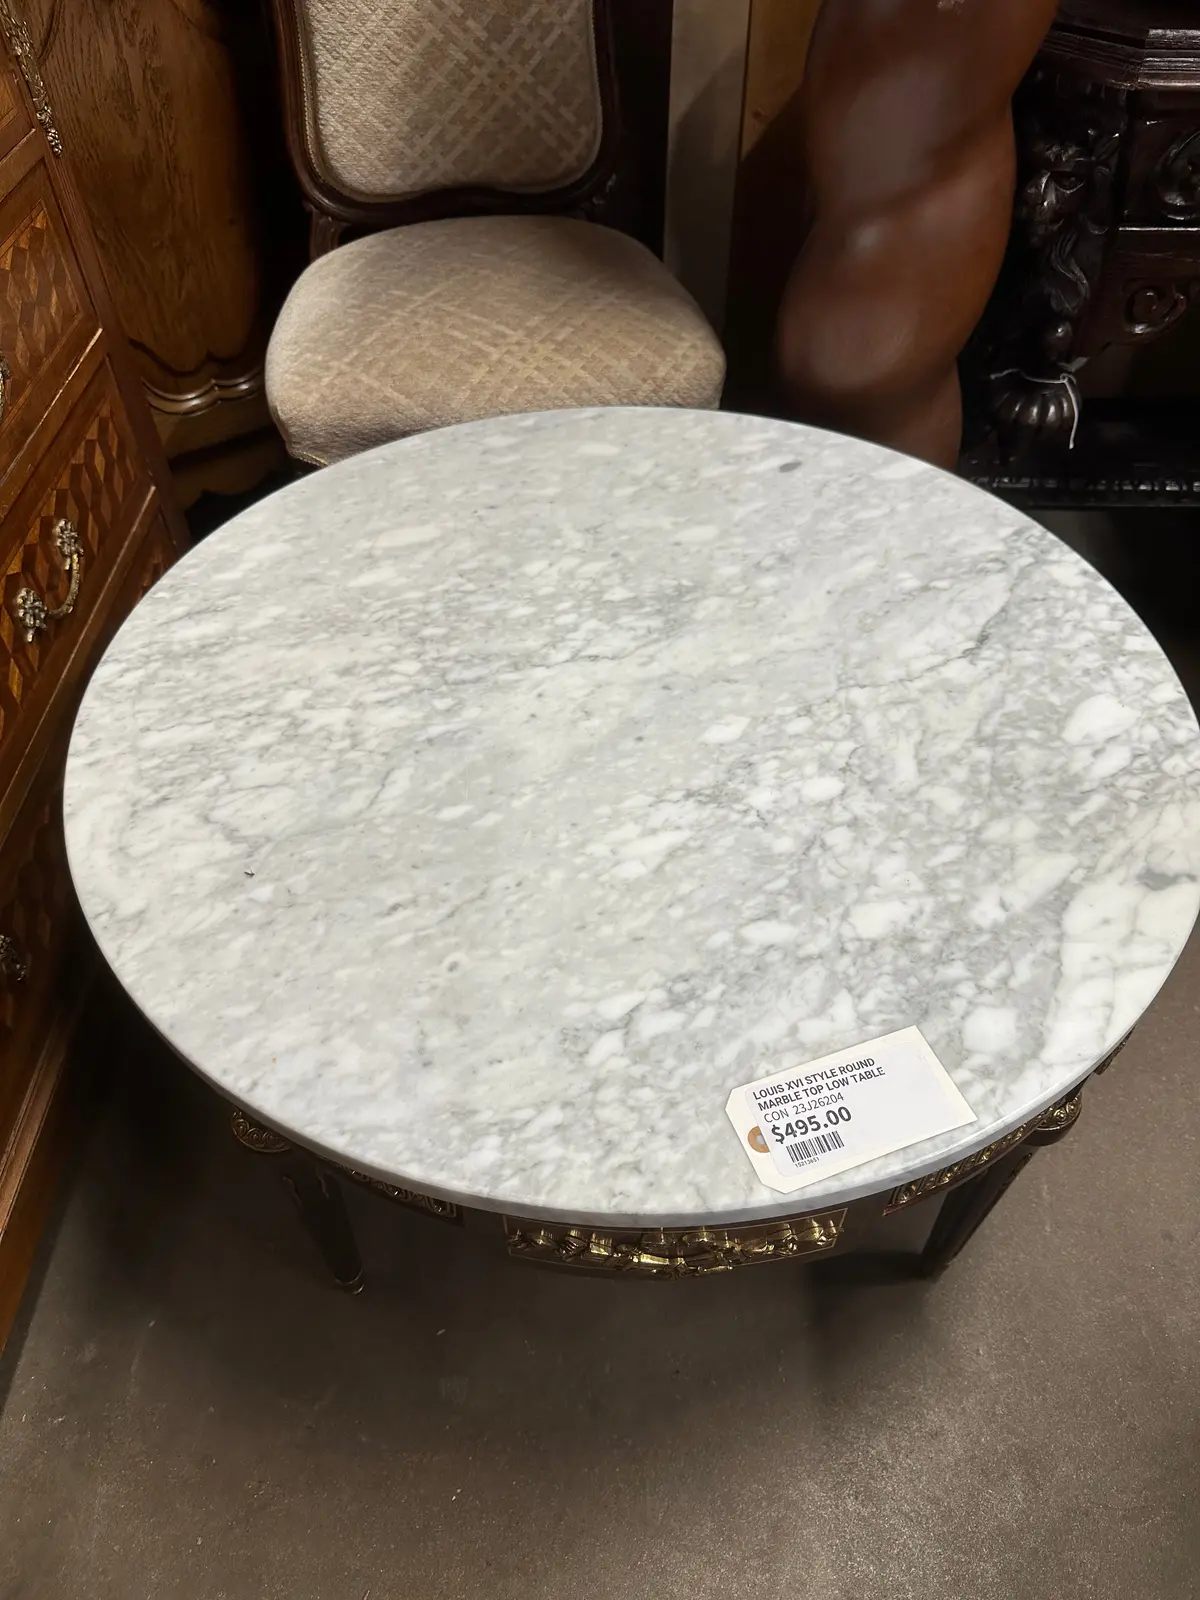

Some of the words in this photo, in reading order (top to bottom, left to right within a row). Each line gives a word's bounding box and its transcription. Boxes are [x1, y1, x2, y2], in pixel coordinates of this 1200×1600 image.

[753, 1084, 785, 1100] LOUIS
[785, 1078, 804, 1091] XVI
[804, 1068, 838, 1085] STYLE
[838, 1058, 875, 1075] ROUND
[758, 1091, 803, 1111] MARBLE
[802, 1084, 824, 1098] TOP
[826, 1077, 850, 1091] LOW
[850, 1067, 885, 1084] TABLE
[764, 1108, 789, 1123] CON
[792, 1092, 844, 1115] 23J26204
[771, 1106, 852, 1144] $495.00
